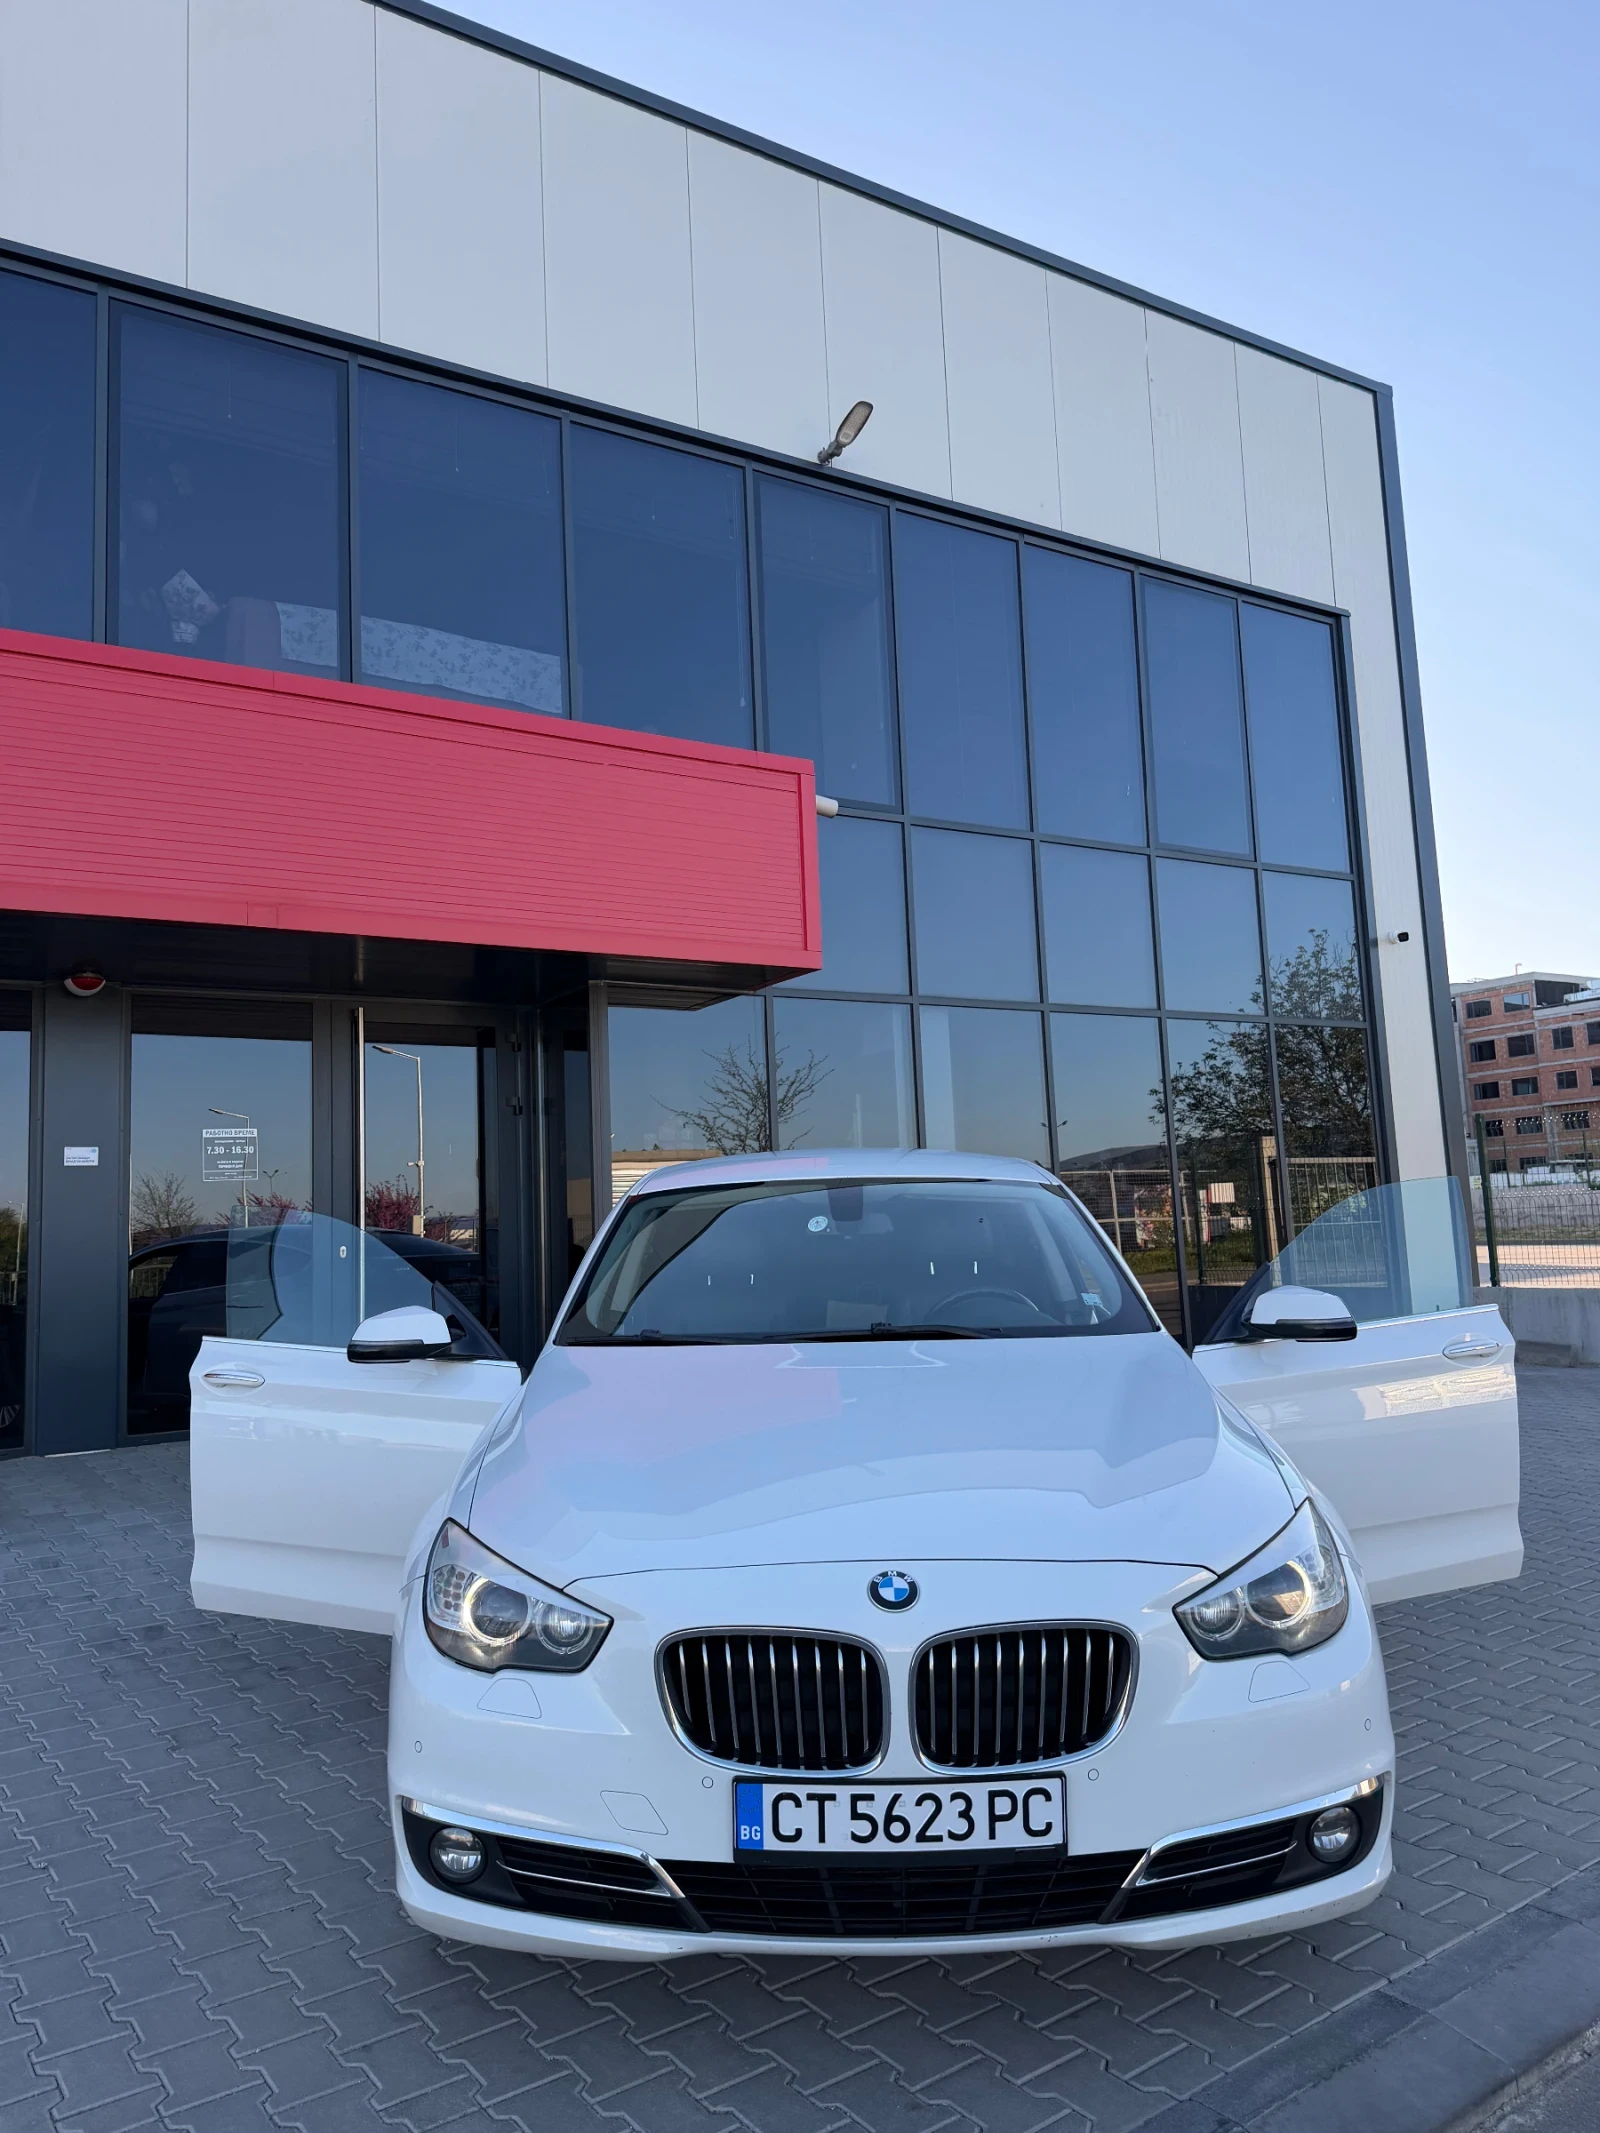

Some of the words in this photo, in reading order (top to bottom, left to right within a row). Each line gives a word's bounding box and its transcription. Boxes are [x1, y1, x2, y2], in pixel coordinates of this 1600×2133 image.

[873, 1570, 914, 1583] BMW
[849, 1791, 975, 1844] 5623
[740, 1825, 761, 1841] BG
